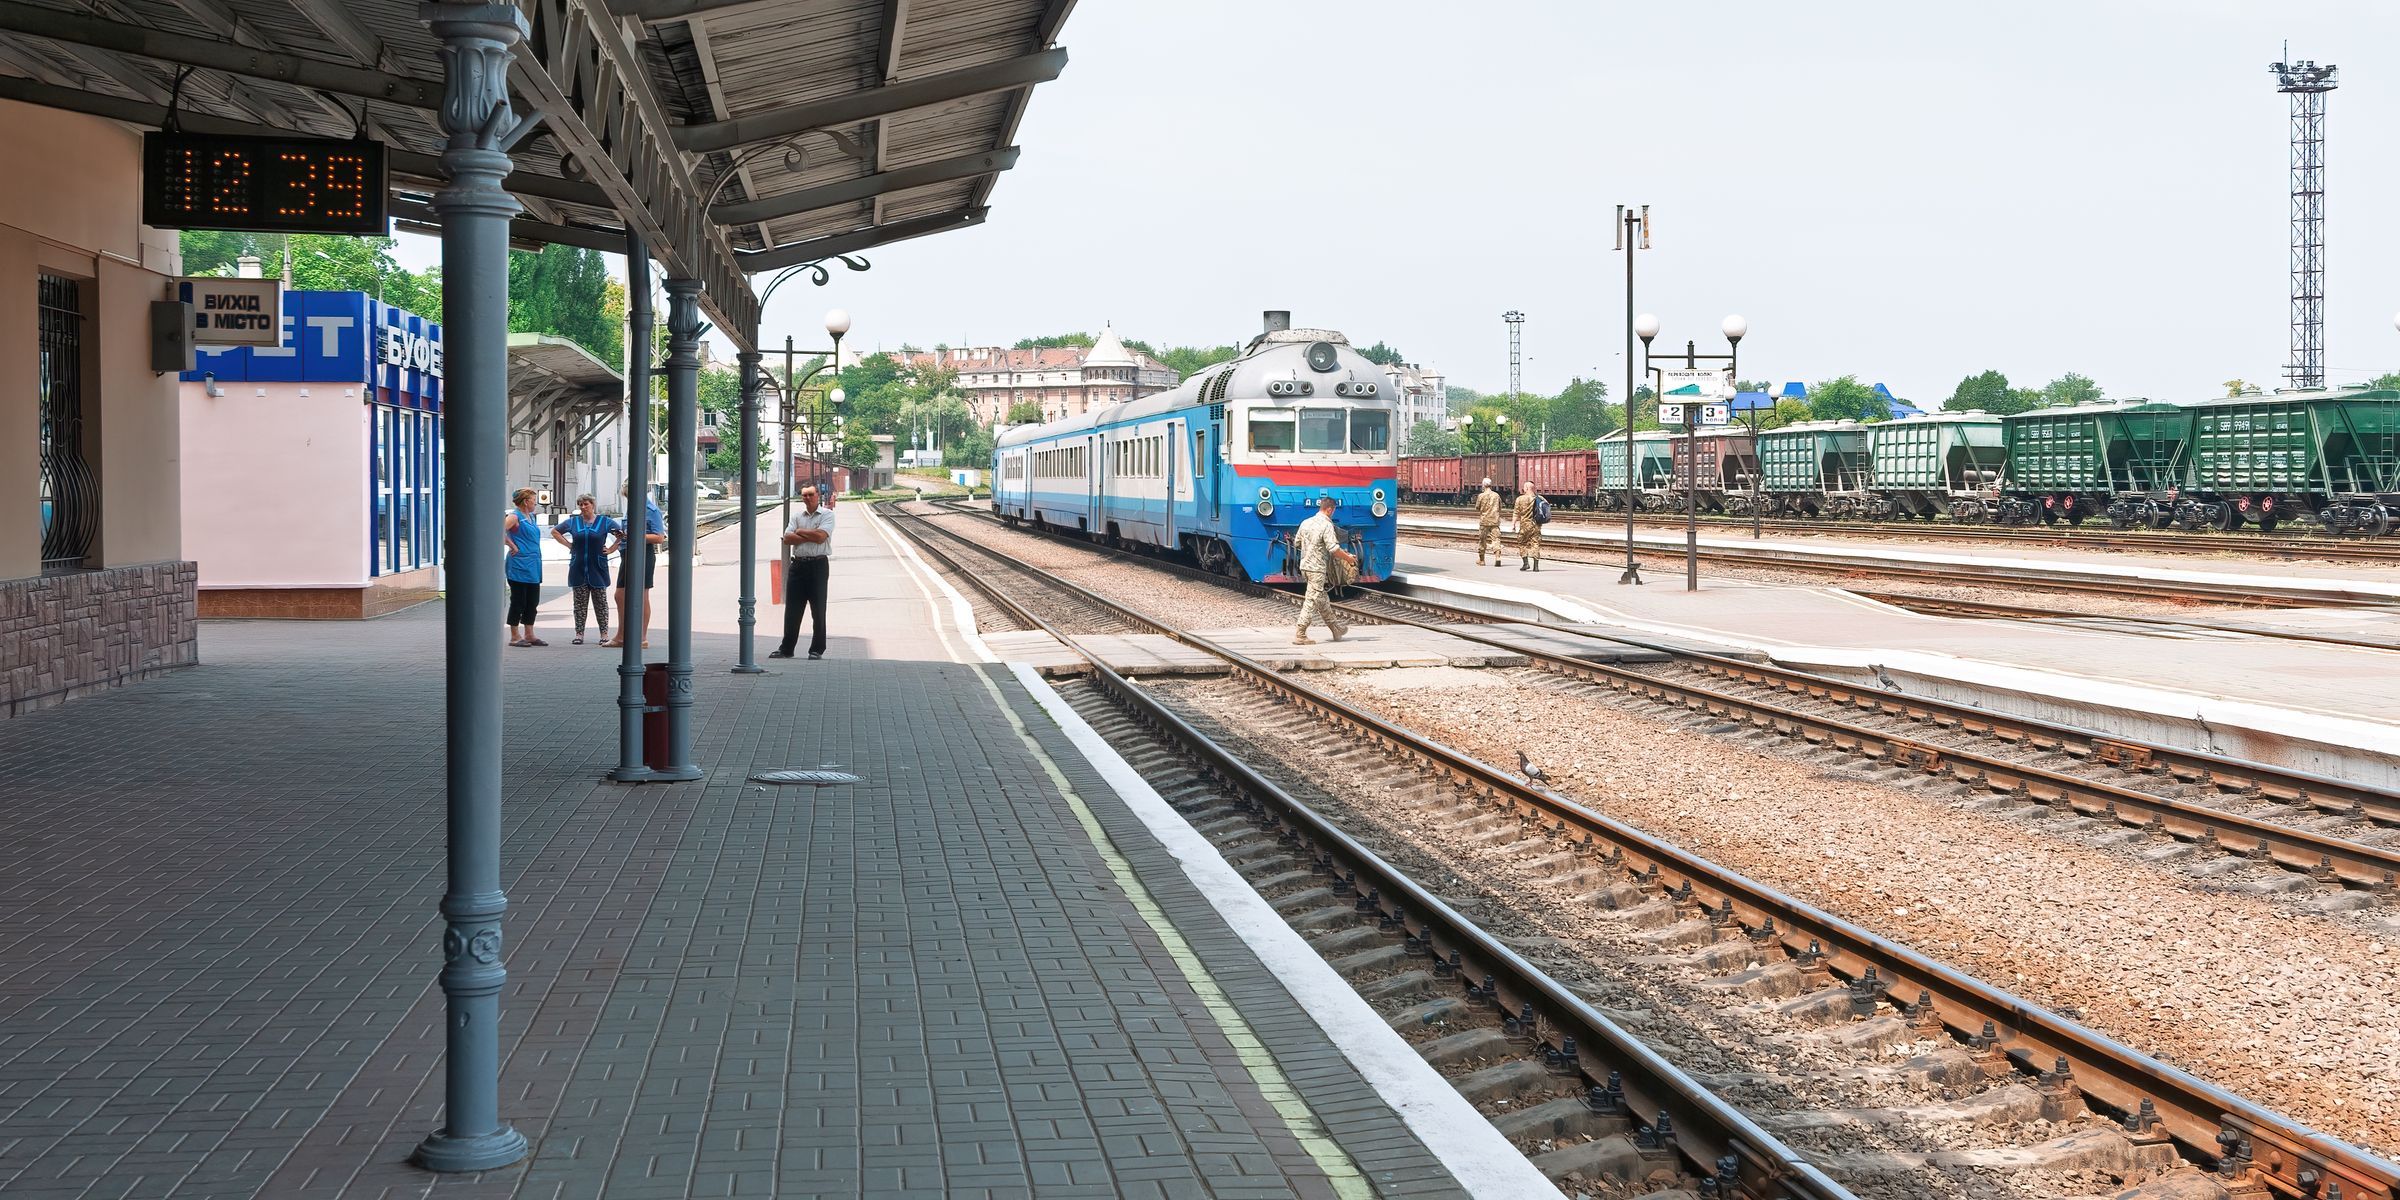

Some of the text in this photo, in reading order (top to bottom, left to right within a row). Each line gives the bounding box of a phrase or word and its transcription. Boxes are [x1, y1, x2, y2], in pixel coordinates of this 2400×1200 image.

[183, 149, 363, 218] 12 39
[204, 294, 261, 312] ВИХІД
[214, 313, 271, 330] МІСТО
[387, 325, 444, 379] БУФЕ
[1670, 407, 1680, 417] 2
[1705, 407, 1715, 417] 3
